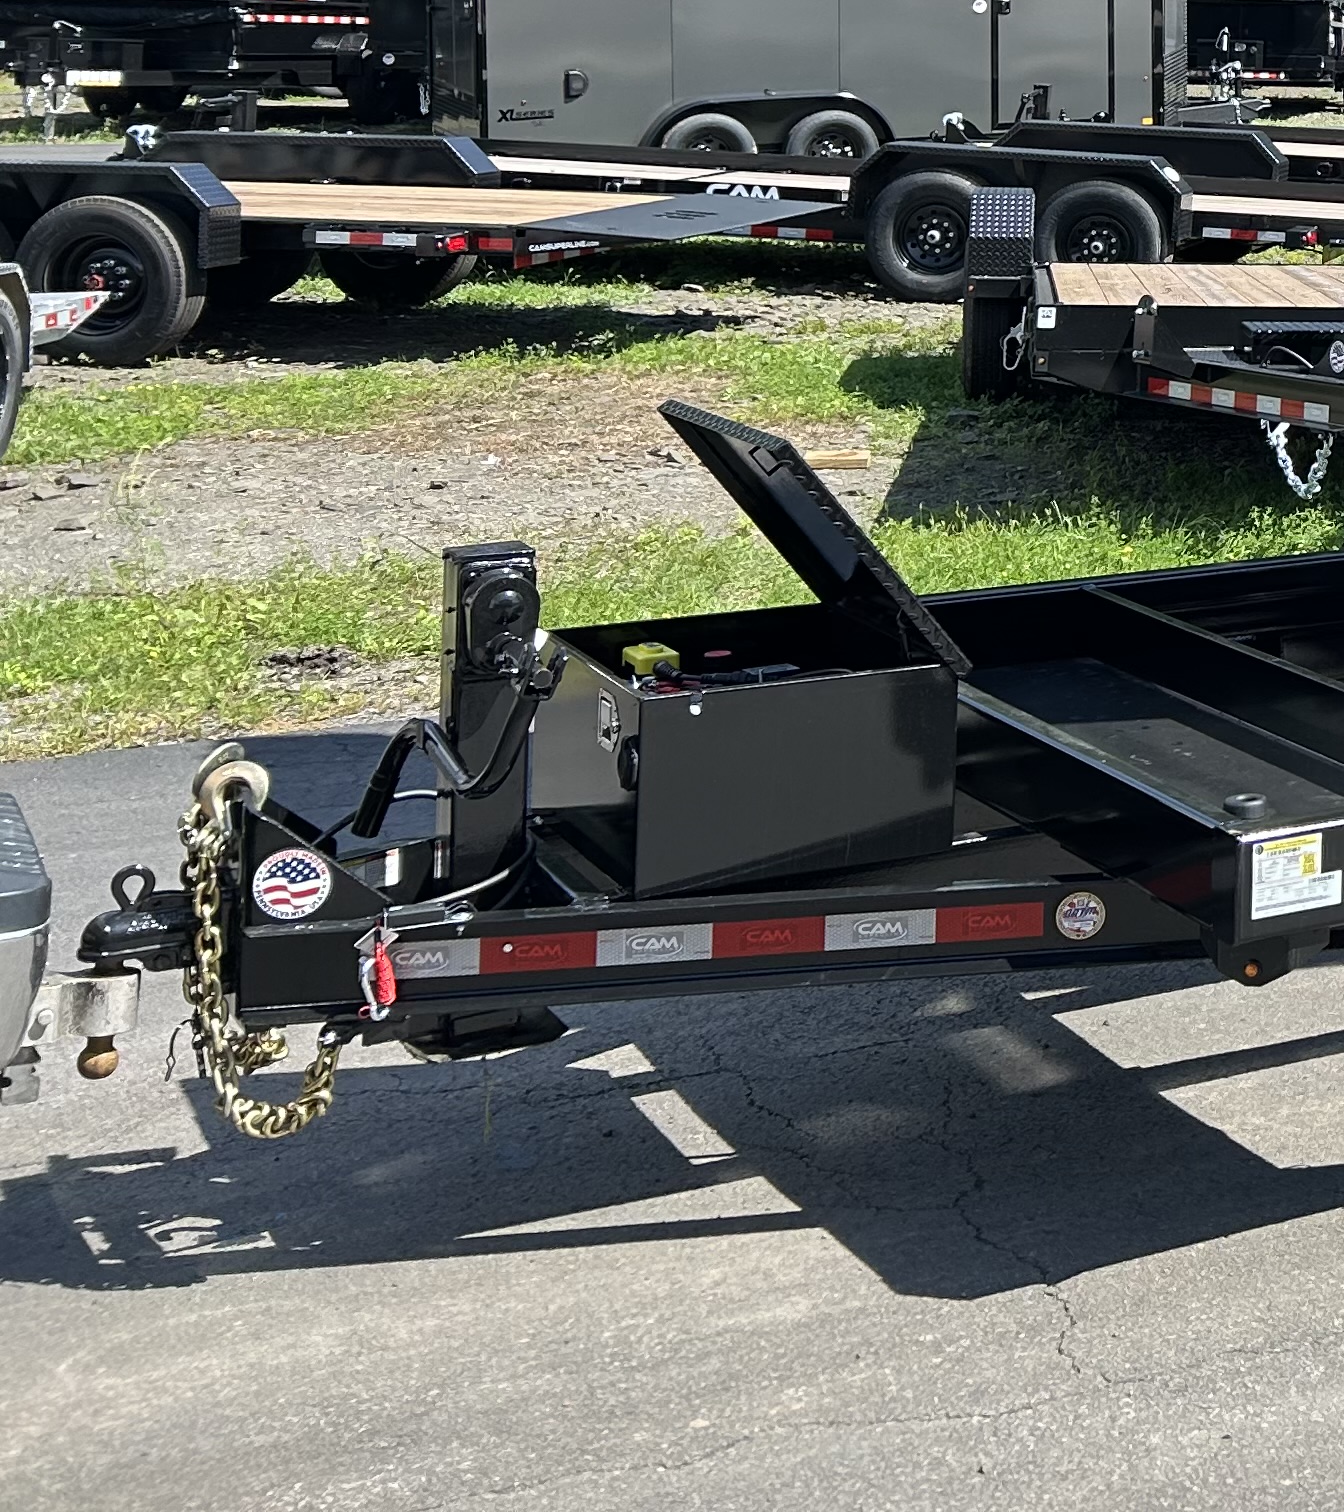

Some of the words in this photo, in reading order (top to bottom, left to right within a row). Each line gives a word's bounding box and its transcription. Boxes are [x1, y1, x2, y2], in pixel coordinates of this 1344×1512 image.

[857, 921, 905, 937] CAM
[968, 915, 1012, 928] CAM
[745, 928, 792, 943] CAM
[515, 943, 563, 959] CAM
[630, 936, 680, 951] CAM
[395, 950, 444, 966] CAM
